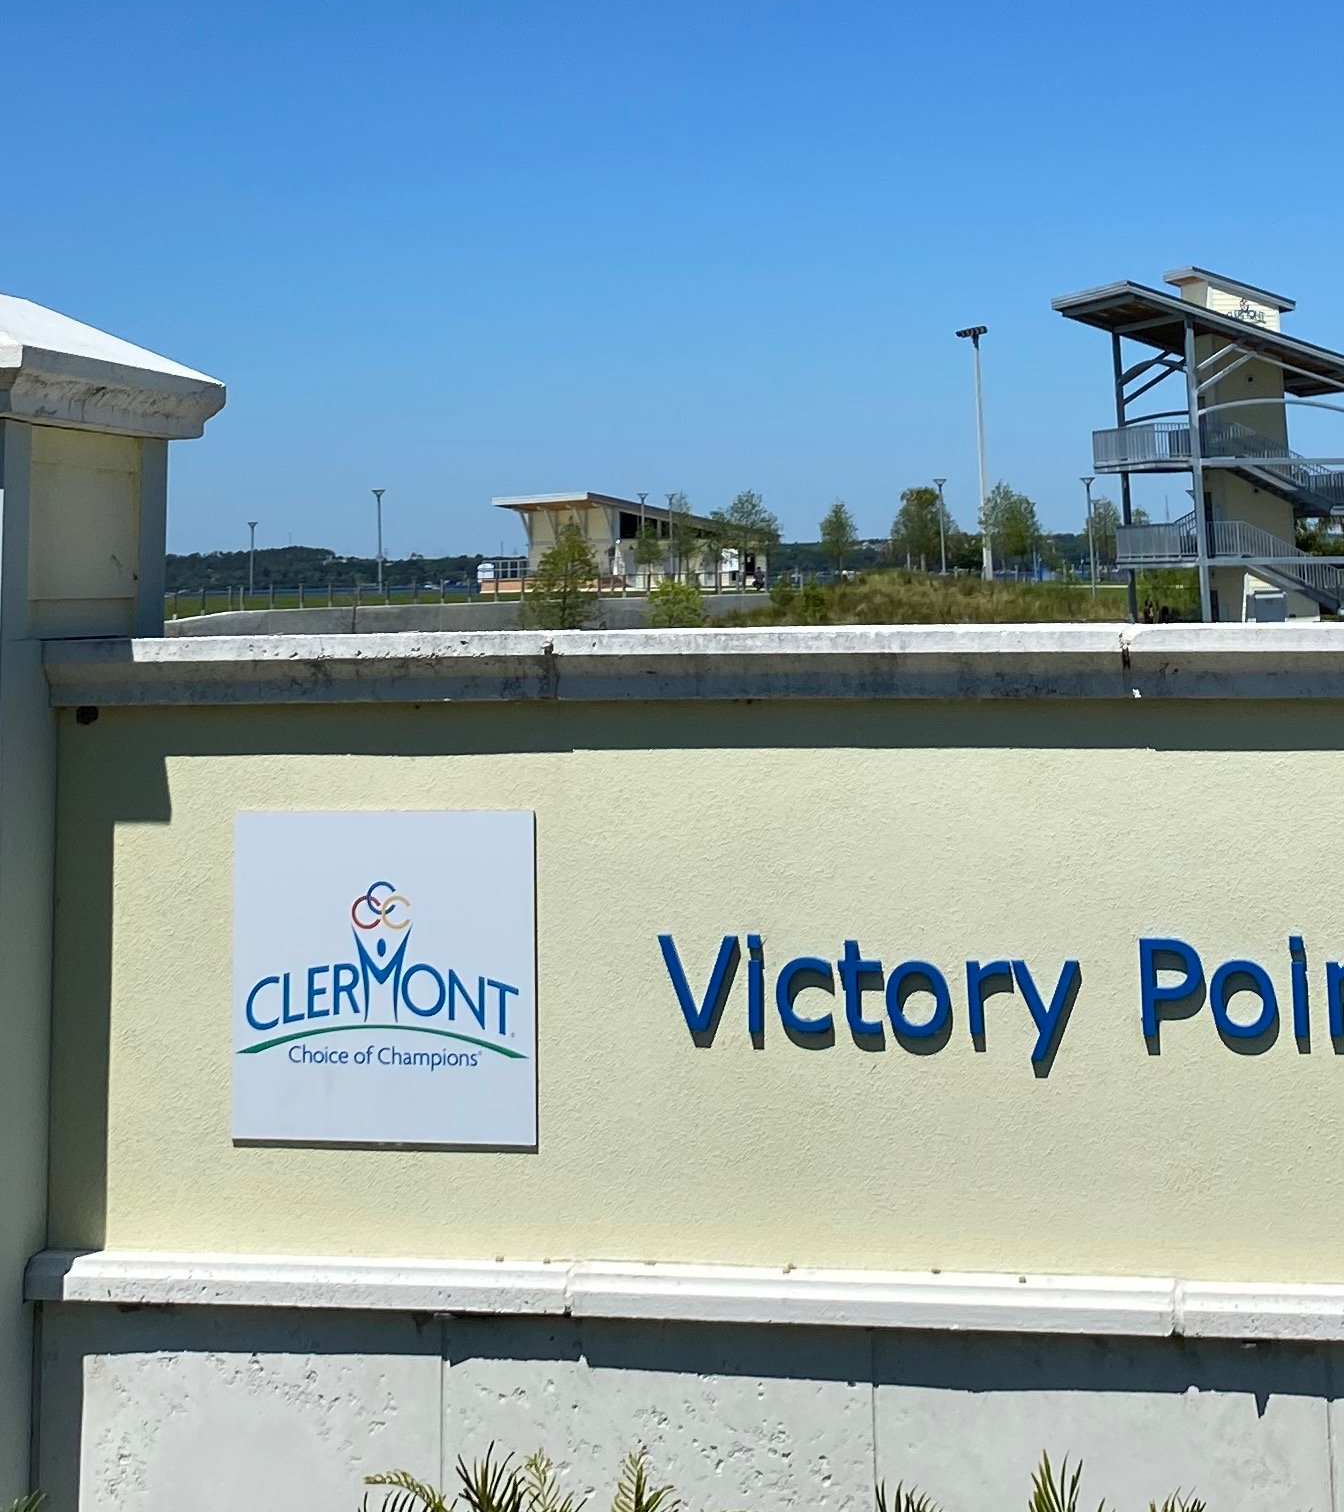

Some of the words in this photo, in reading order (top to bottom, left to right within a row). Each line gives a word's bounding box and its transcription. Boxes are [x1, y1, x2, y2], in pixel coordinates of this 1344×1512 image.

[246, 924, 519, 1036] CLERMONT
[658, 934, 1080, 1070] Victory
[288, 1044, 349, 1064] Choice
[353, 1045, 375, 1065] of
[377, 1046, 479, 1072] Champions
